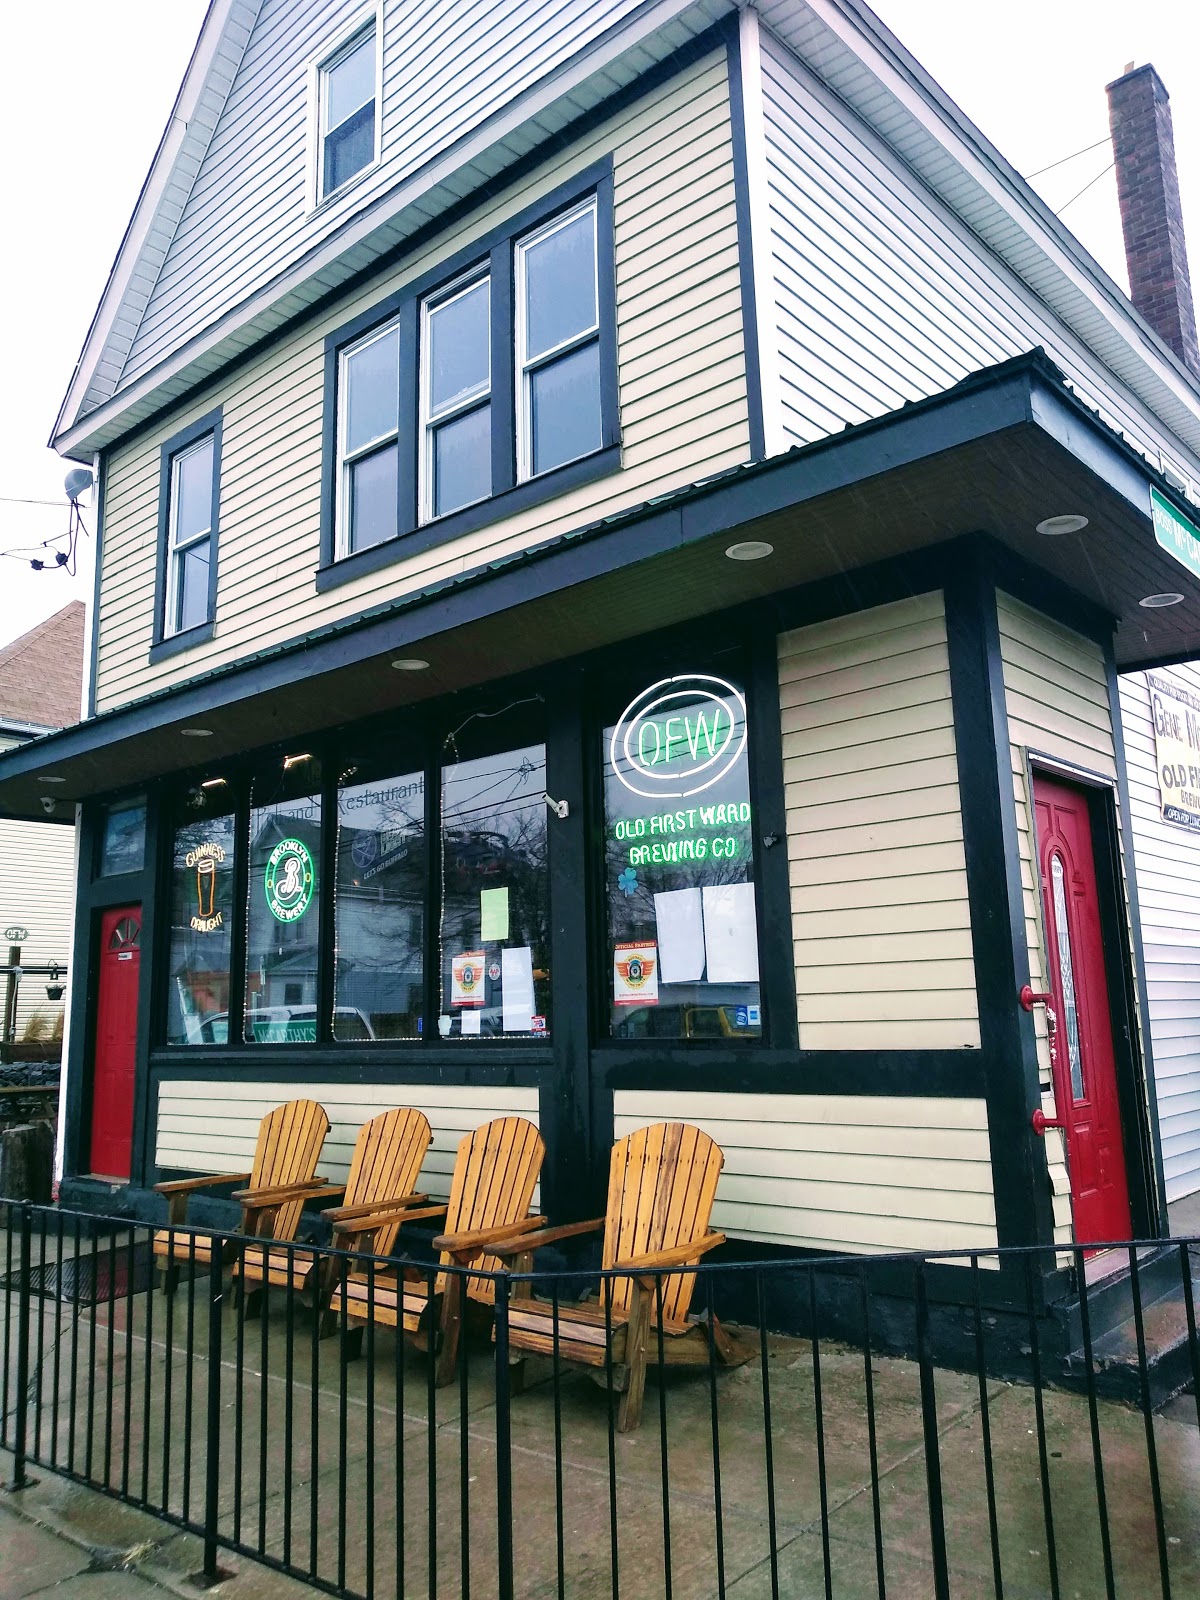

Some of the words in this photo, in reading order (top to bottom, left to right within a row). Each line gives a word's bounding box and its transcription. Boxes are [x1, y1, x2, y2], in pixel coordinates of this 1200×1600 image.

[638, 709, 720, 766] OFW
[1162, 764, 1187, 789] OLD
[1188, 765, 1200, 789] FI
[615, 818, 646, 840] OLD
[650, 809, 697, 835] FIRST
[699, 802, 751, 825] WARD
[1167, 808, 1180, 821] OPEN
[1180, 812, 1189, 824] FOR
[185, 843, 226, 867] GUINNESS
[270, 841, 309, 866] BROOKLYN
[629, 837, 708, 866] BREWING
[712, 837, 736, 858] CO
[271, 892, 308, 920] BREWERY
[190, 911, 223, 932] DRAUGHT
